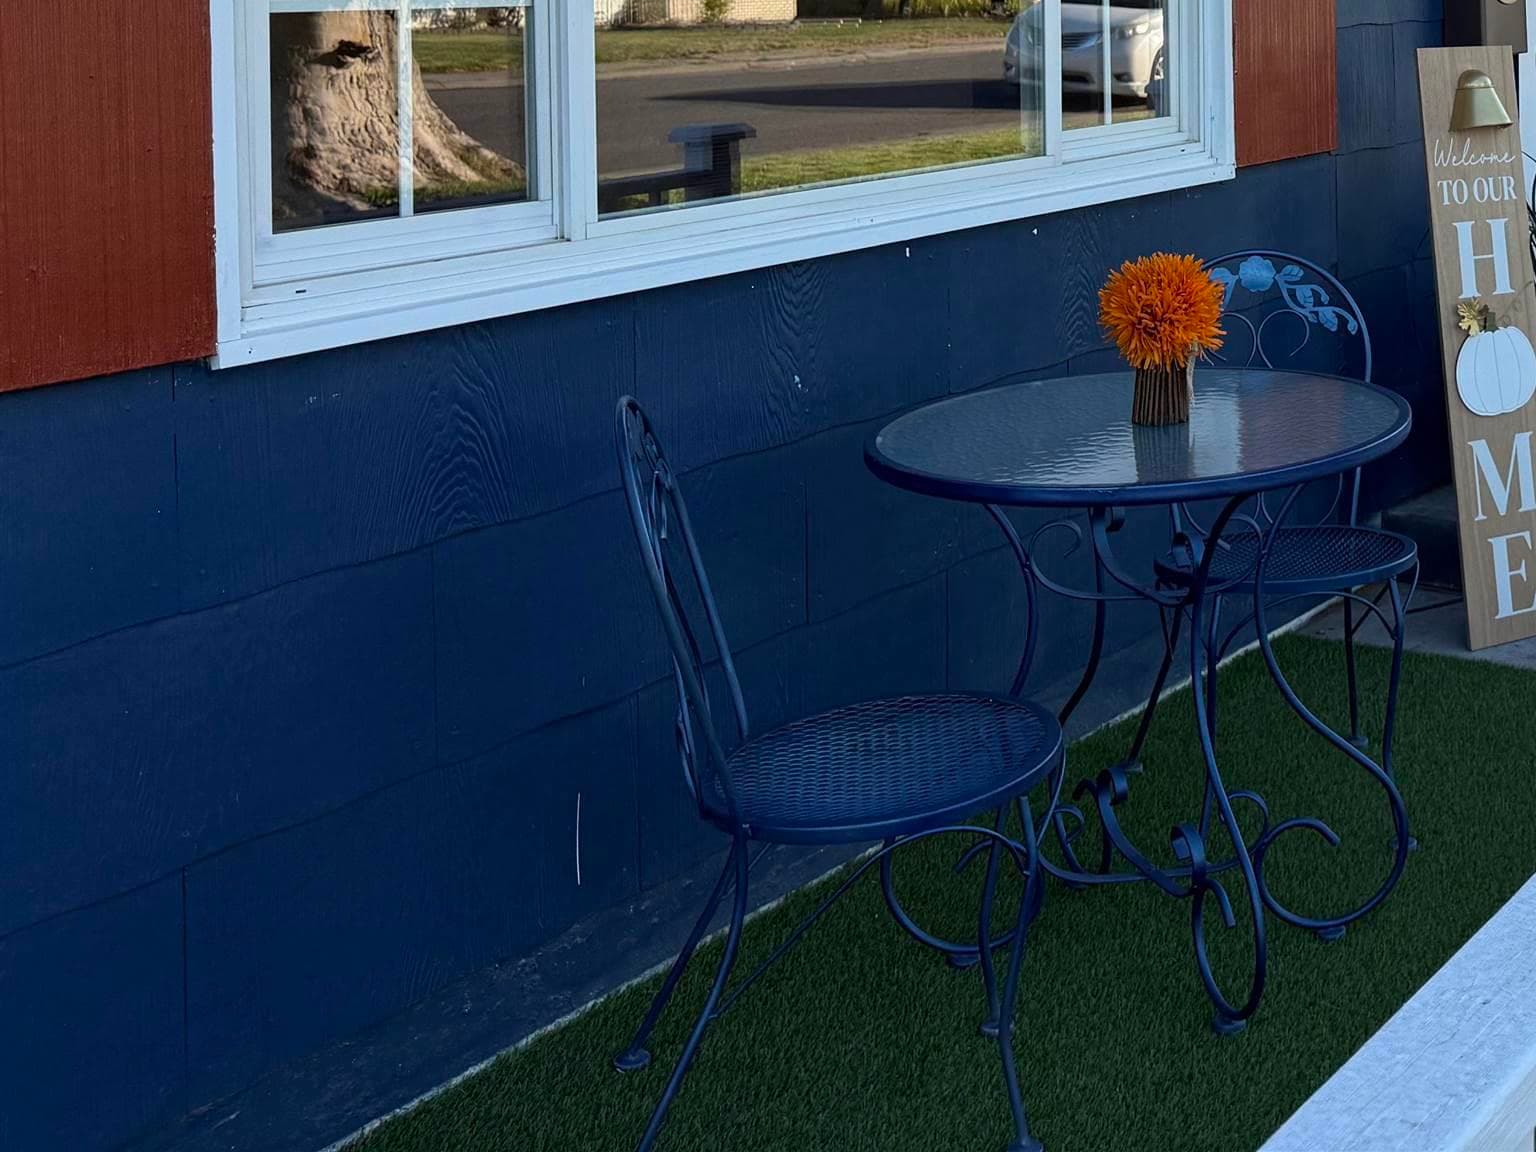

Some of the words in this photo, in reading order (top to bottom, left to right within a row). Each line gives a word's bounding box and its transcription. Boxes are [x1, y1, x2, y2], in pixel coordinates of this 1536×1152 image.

[1434, 137, 1516, 167] Welcome
[1437, 178, 1469, 206] TO
[1472, 175, 1518, 203] OUR
